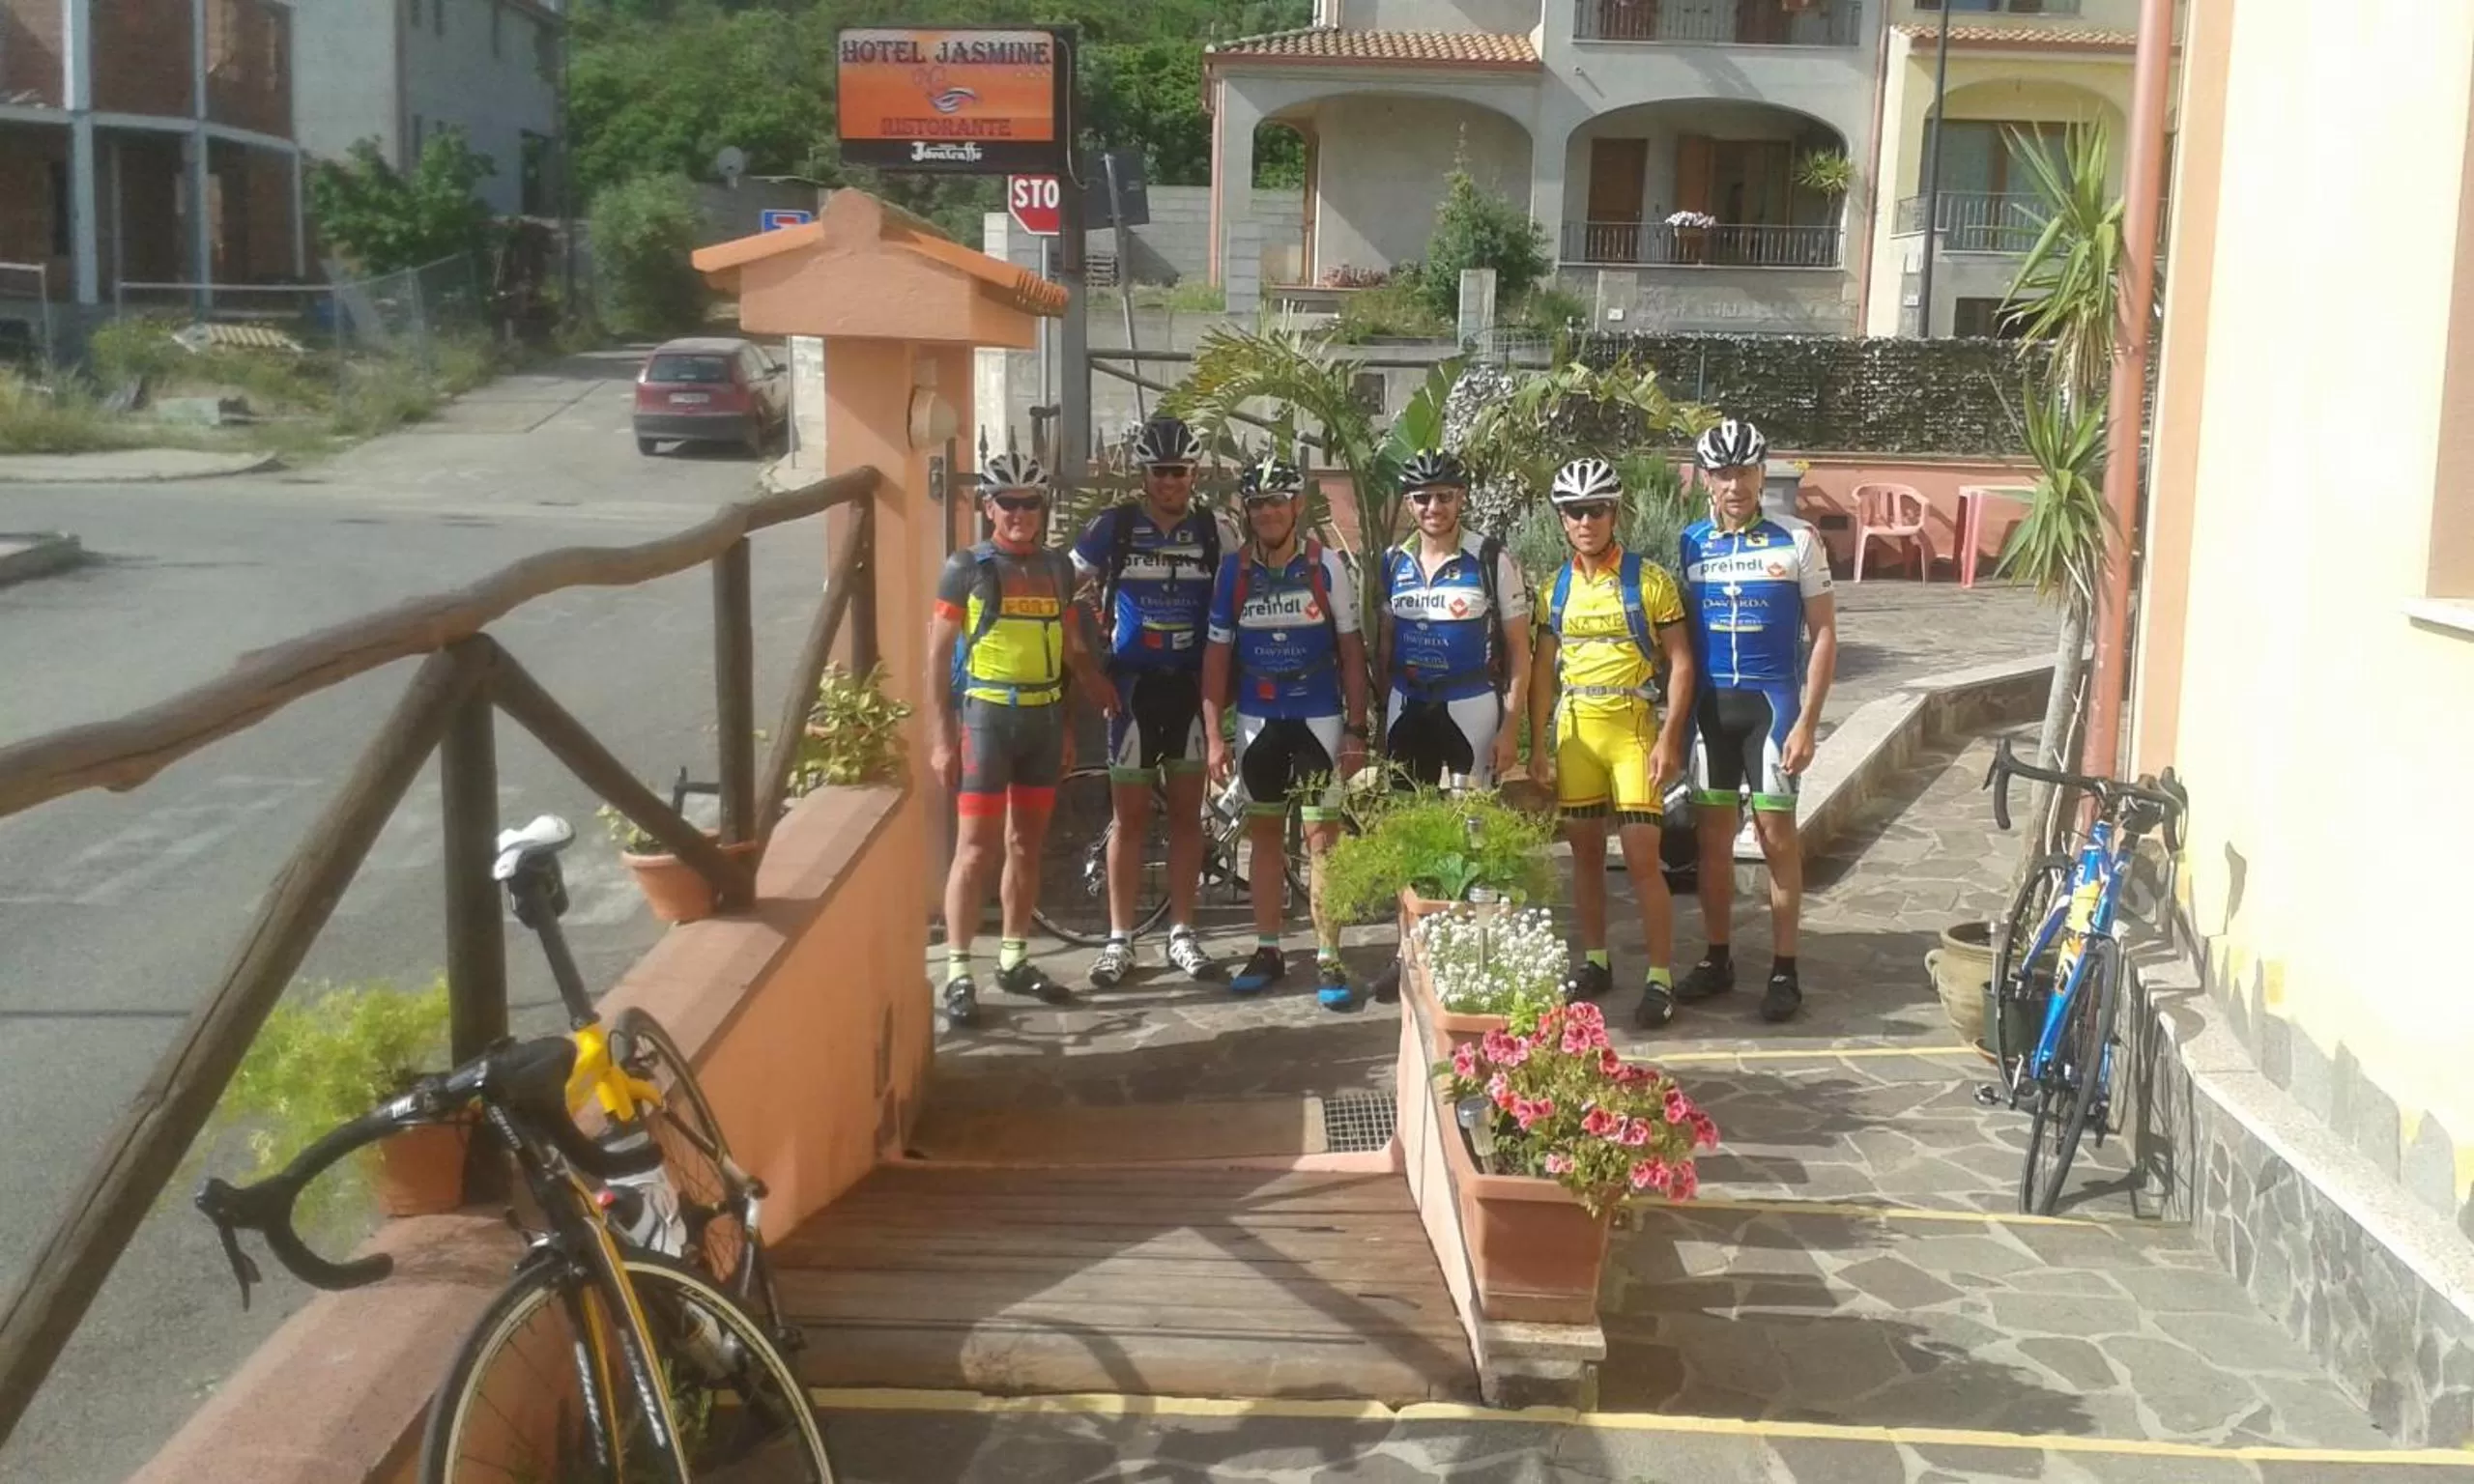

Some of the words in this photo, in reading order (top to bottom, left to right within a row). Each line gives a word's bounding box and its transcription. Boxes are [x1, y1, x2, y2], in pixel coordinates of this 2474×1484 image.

[842, 41, 926, 64] HOTEL
[935, 42, 1051, 66] JASMINE
[880, 117, 1012, 137] RISTORANTE
[1703, 557, 1764, 576] preindl
[1394, 593, 1446, 611] preindl
